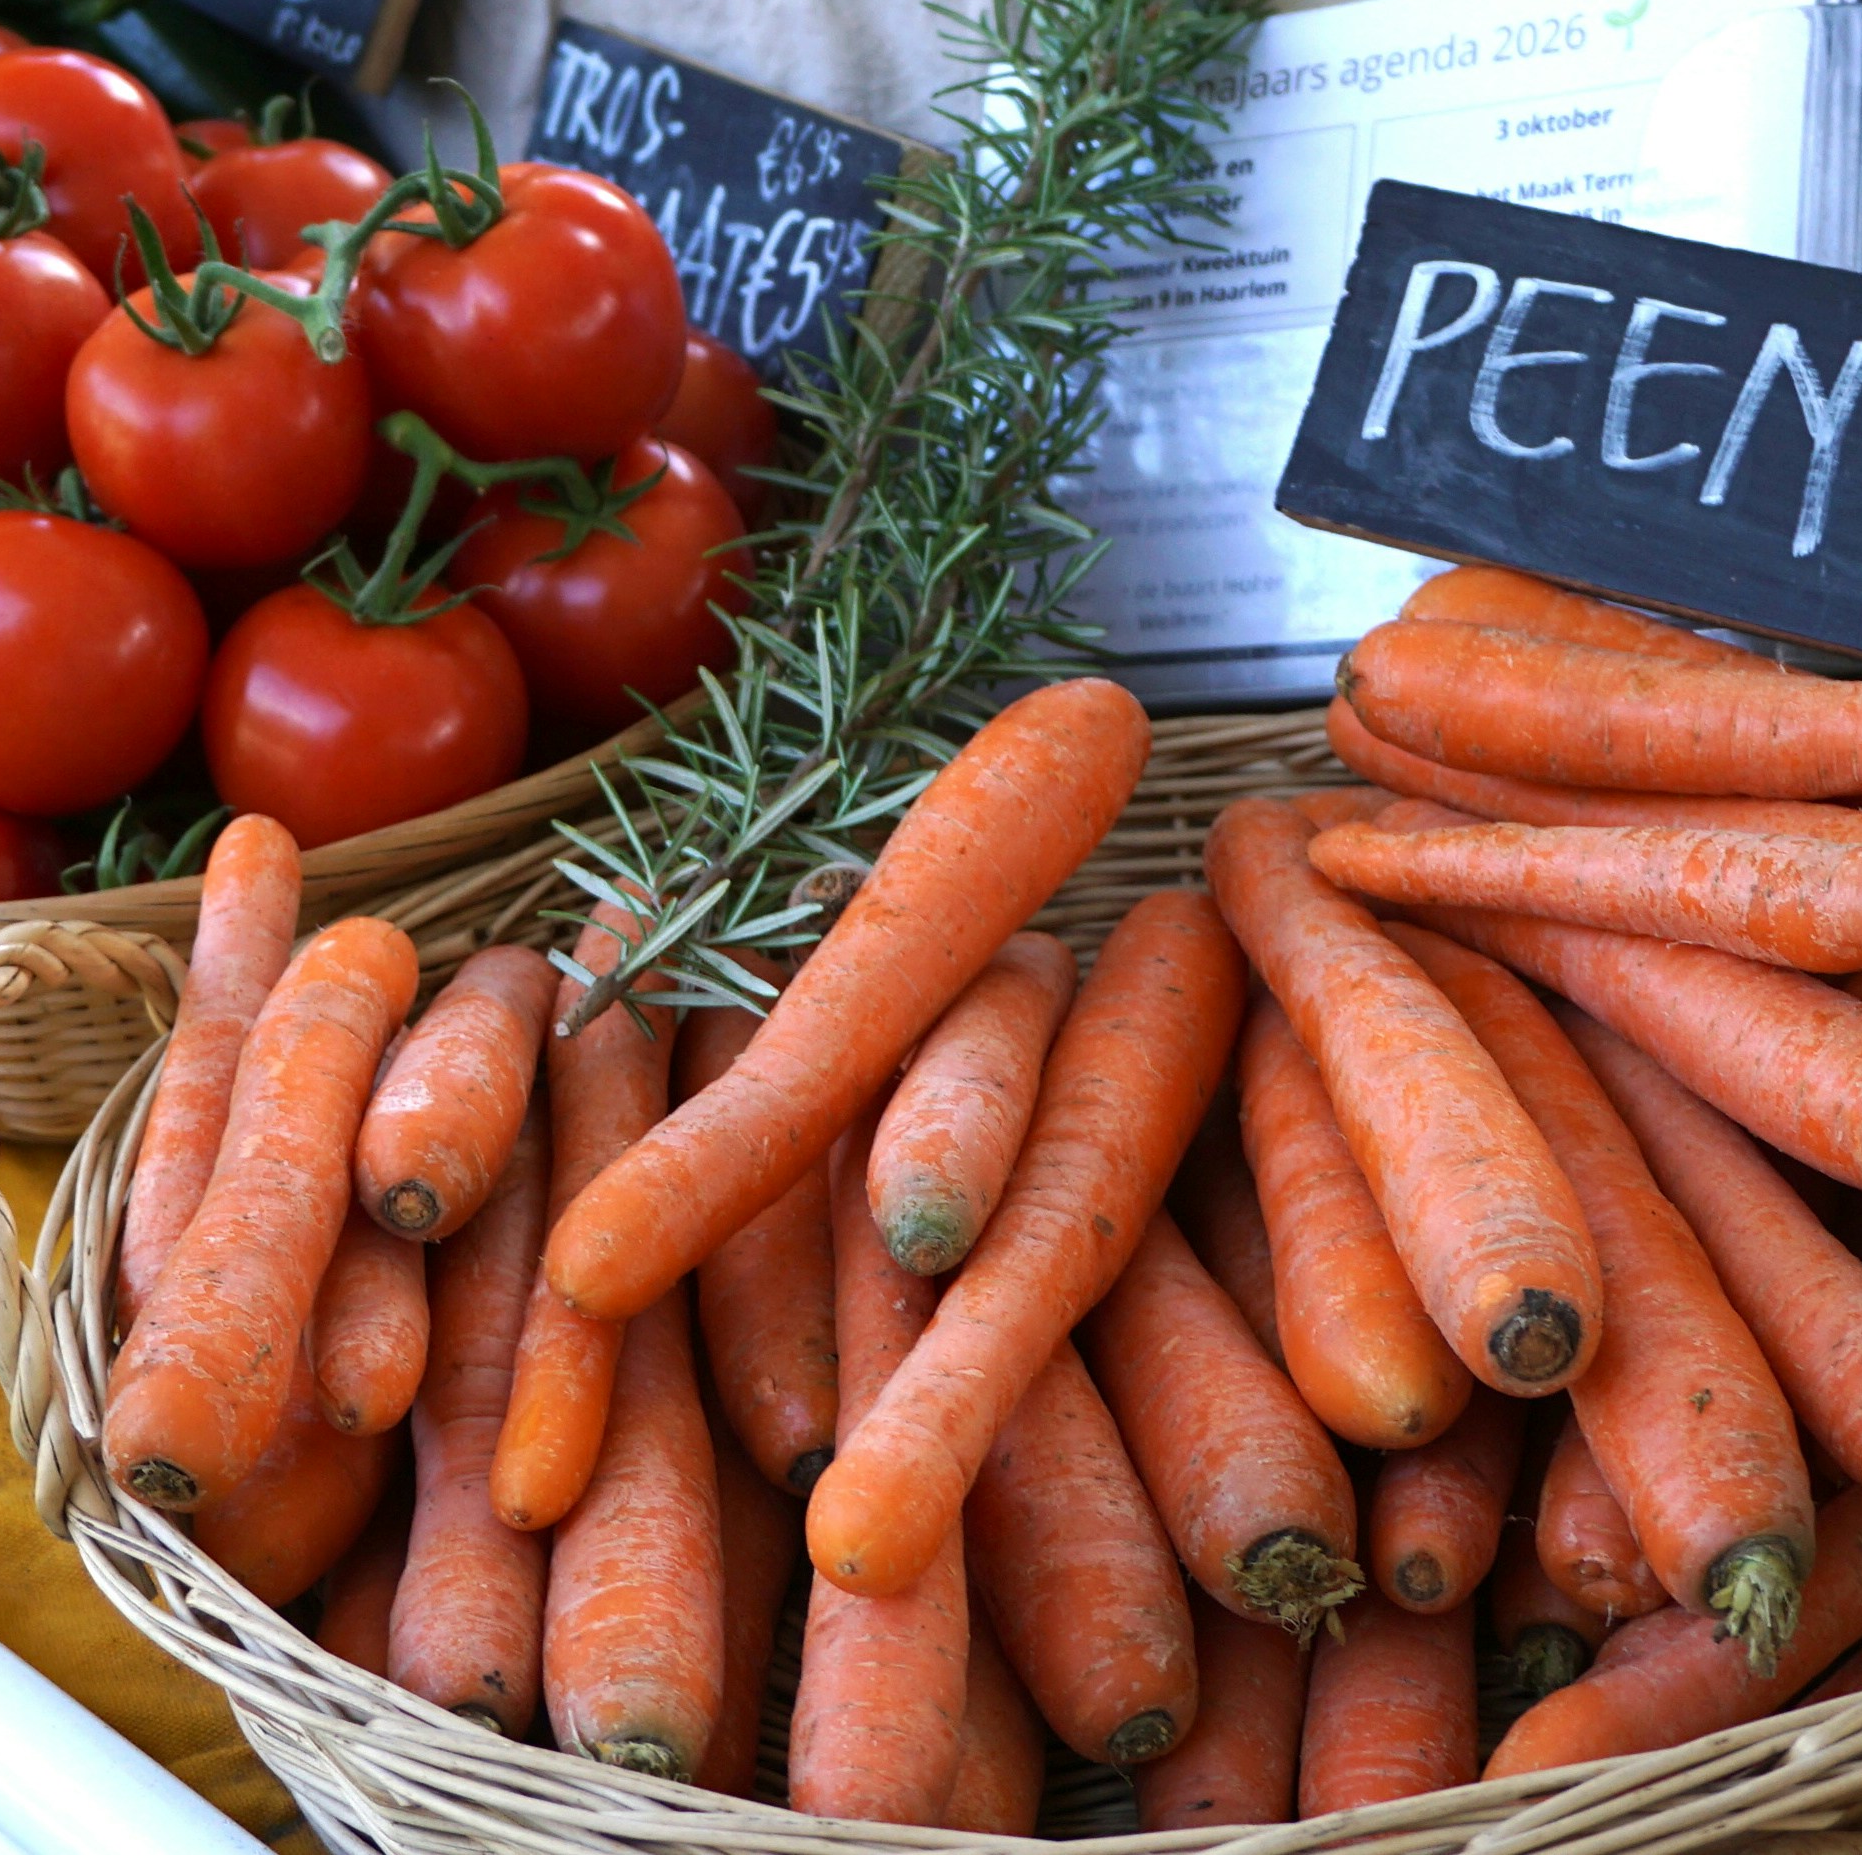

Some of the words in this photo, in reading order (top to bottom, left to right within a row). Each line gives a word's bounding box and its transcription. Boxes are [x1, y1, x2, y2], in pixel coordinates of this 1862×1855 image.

[1338, 32, 1479, 95] agenda
[1491, 12, 1588, 64] 2026
[1495, 118, 1510, 141] 3
[1515, 106, 1615, 138] oktober
[1517, 175, 1576, 200] Maak
[1182, 246, 1290, 275] Kweektuin
[1199, 278, 1287, 303] Haarlem
